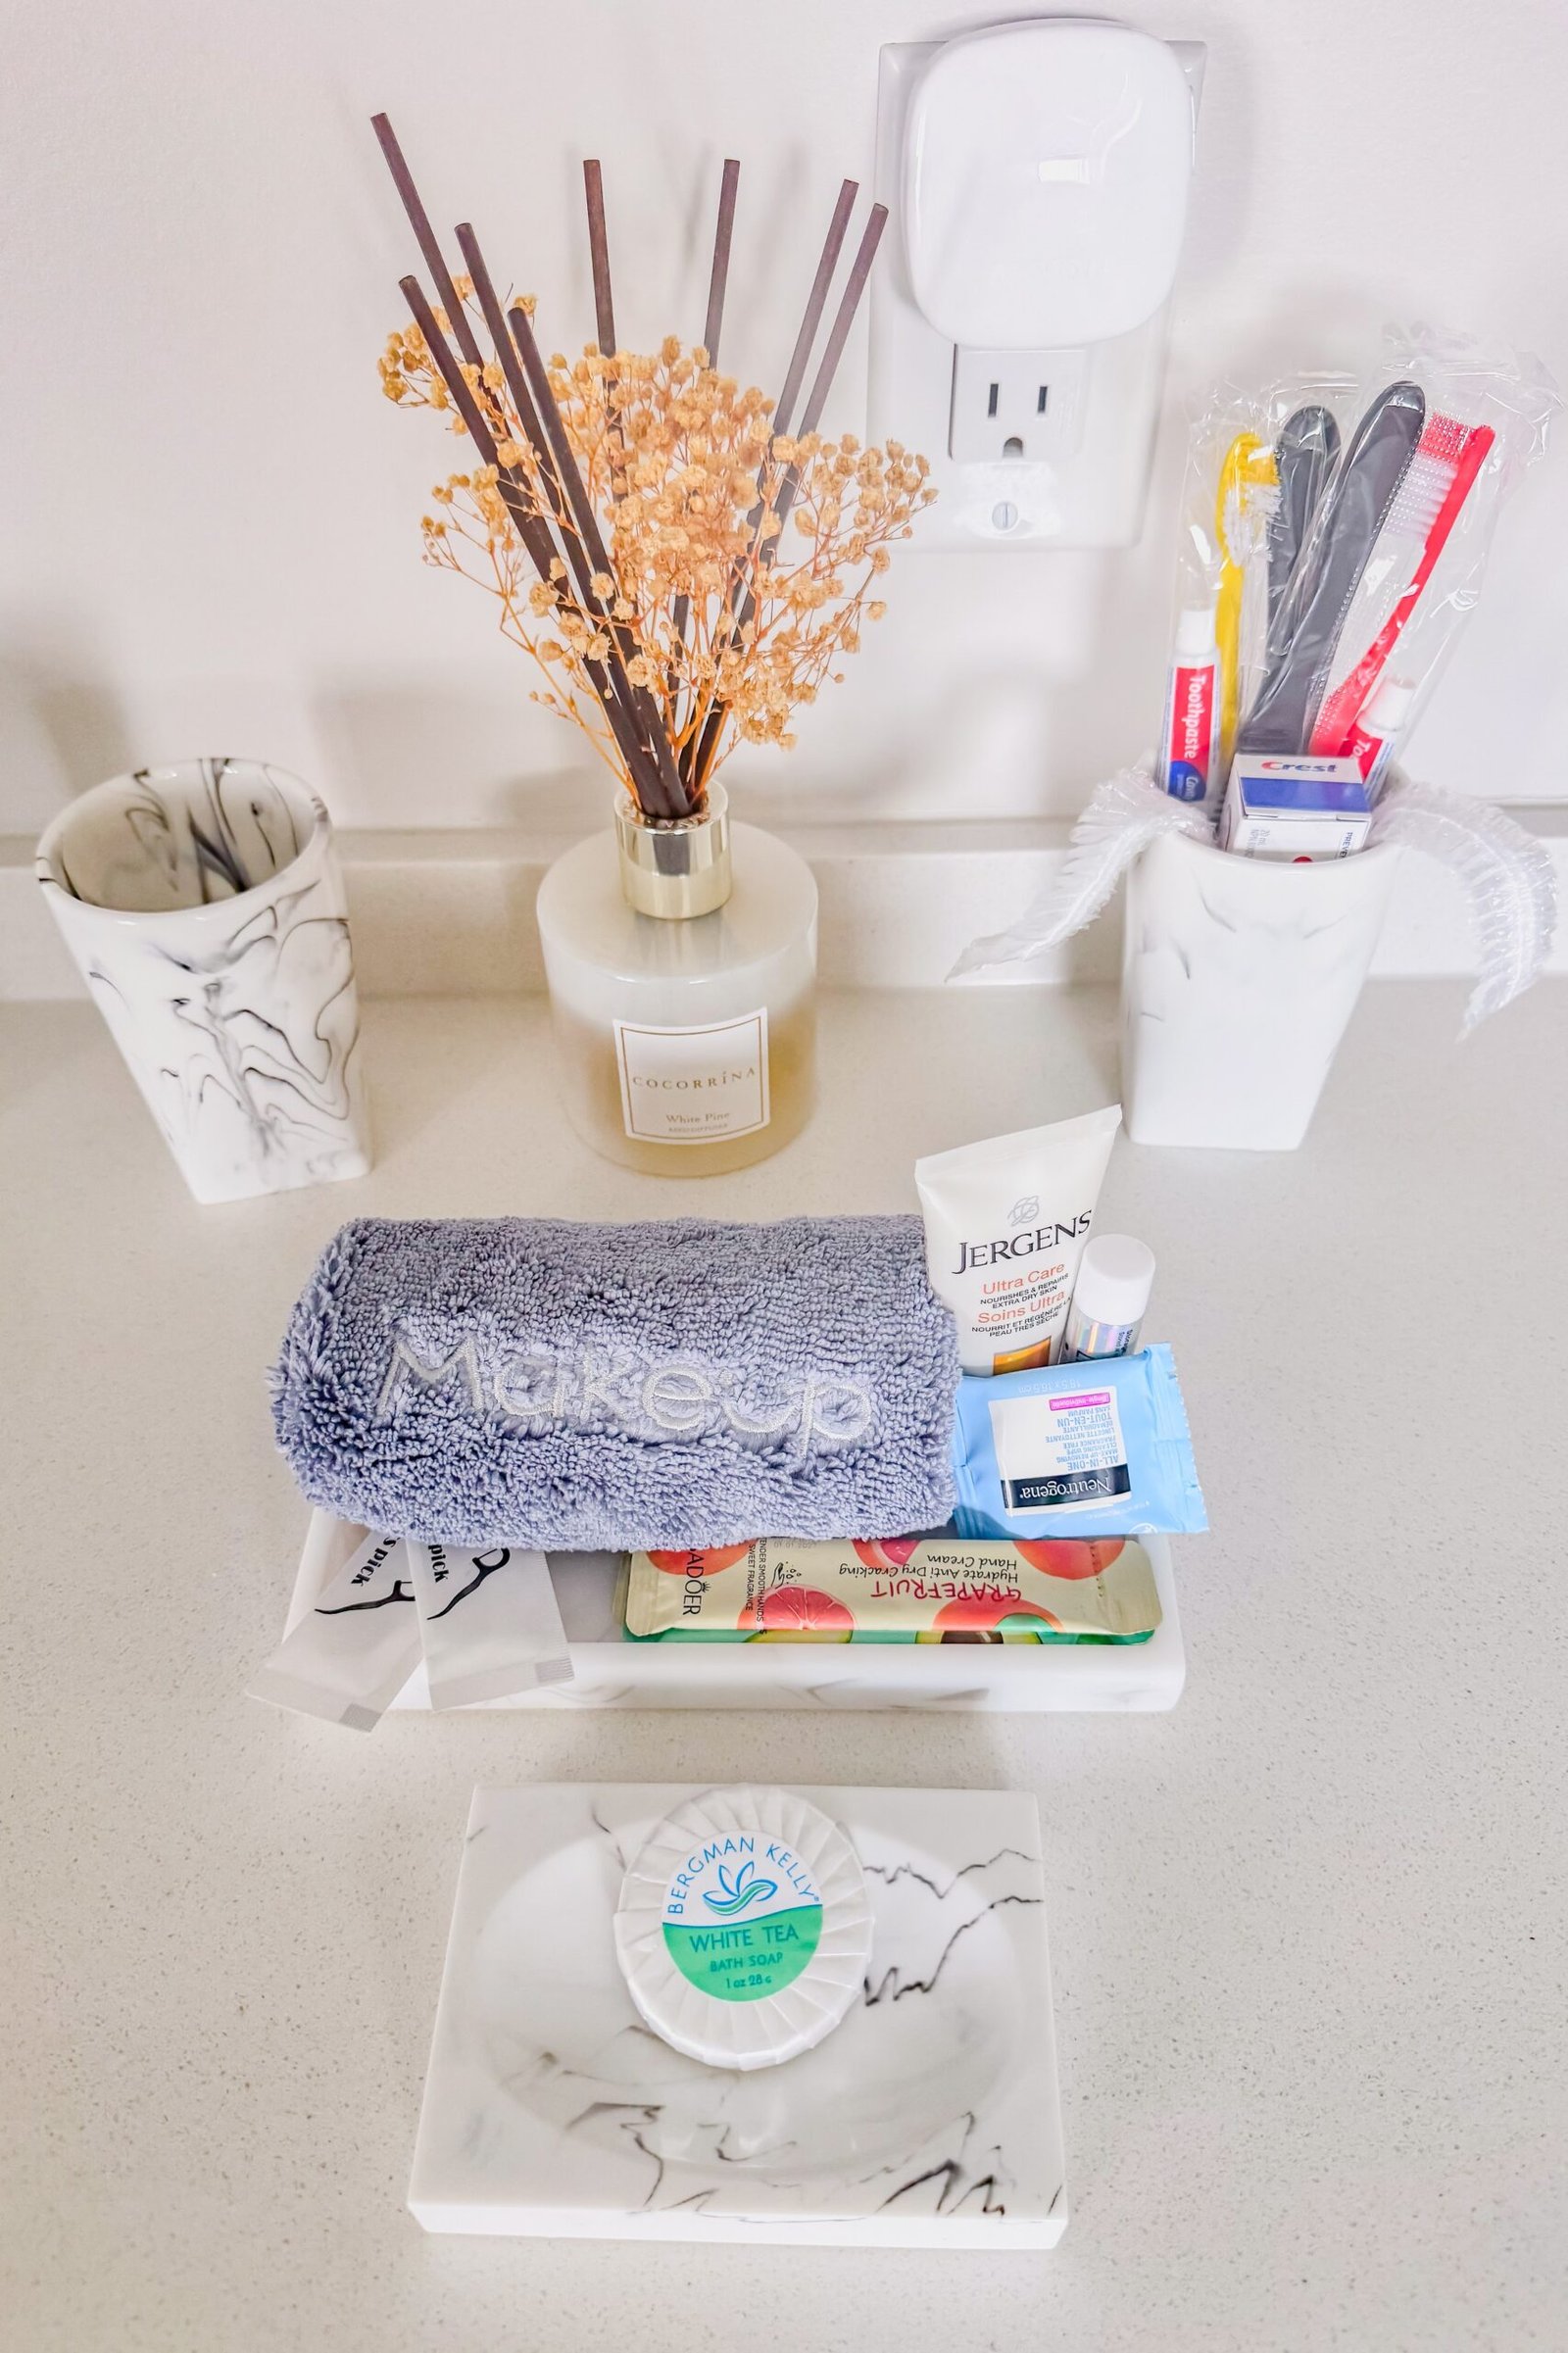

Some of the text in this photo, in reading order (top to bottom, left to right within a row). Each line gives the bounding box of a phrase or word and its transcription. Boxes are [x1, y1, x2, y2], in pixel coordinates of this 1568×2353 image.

[1181, 674, 1207, 759] Toothpaste
[1261, 761, 1338, 772] Crest
[666, 1112, 730, 1124] White Pine
[952, 1209, 1093, 1275] JERGENS
[980, 1288, 1030, 1304] NOURISHES
[1038, 1273, 1069, 1291] REPAIRS
[983, 1263, 1065, 1295] Ultra Care
[978, 1291, 1065, 1323] Soins Ultra
[992, 1285, 1057, 1309] EXTRA DRY SKIN
[971, 1323, 1010, 1333] NOURRIT
[1056, 1412, 1112, 1427] TOUT-EN-UN
[1067, 1455, 1119, 1471] ALL-IN-ONE
[1020, 1477, 1111, 1499] Neutrogena
[351, 1547, 389, 1588] pick
[427, 1544, 450, 1583] pick
[839, 1563, 1018, 1584] Hydrate Anti Dry Cracking
[927, 1554, 1017, 1570] Hand Cream
[682, 1549, 707, 1615] ADOER
[745, 1544, 756, 1611] SWEET FRAGRANCE
[757, 1564, 766, 1595] SMOOTH
[870, 1578, 1021, 1603] GRAPEFRUIT
[756, 1595, 764, 1622] HANDS
[667, 1836, 815, 1914] BERGMAN KELLY
[689, 1924, 799, 1953] WHITE TEA
[710, 1951, 783, 1972] BATH SOAP
[733, 1979, 746, 1988] oz
[748, 1973, 762, 1986] 28
